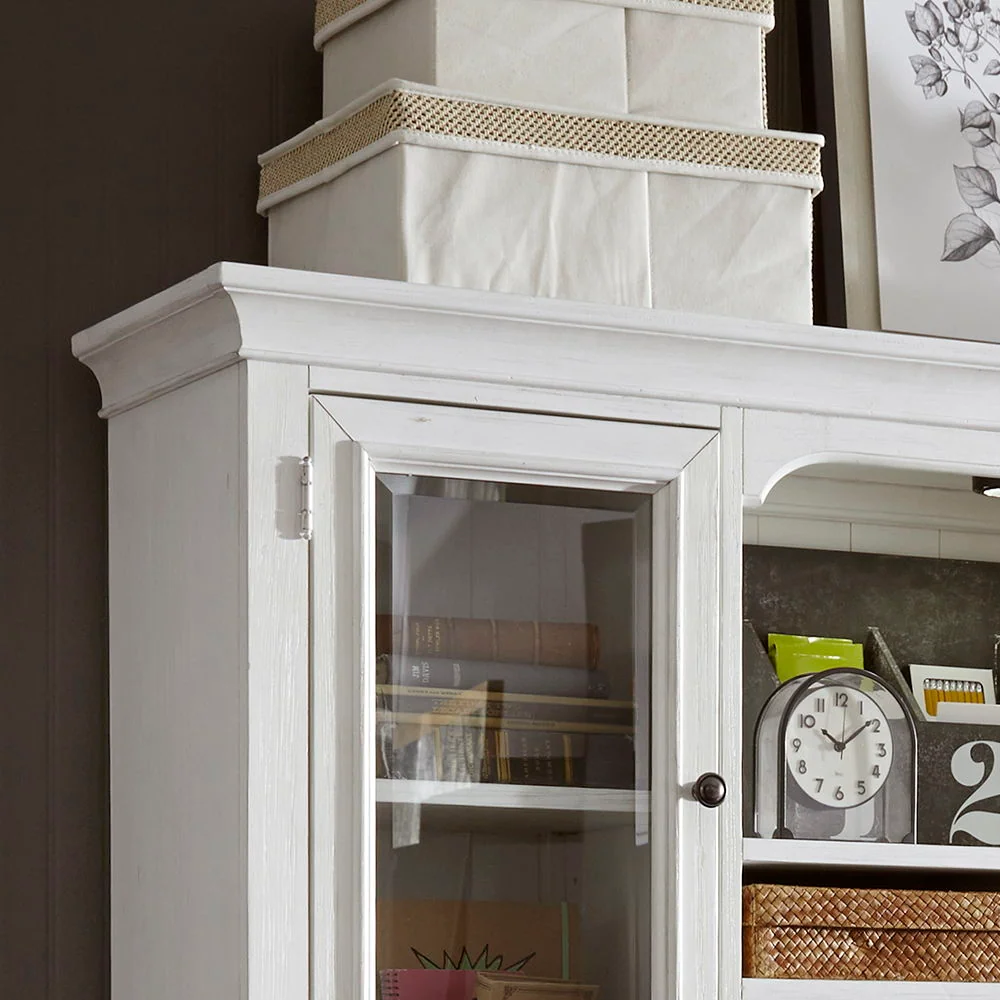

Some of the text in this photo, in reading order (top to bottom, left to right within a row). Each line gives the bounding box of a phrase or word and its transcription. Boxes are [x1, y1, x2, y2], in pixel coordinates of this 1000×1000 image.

[421, 660, 431, 683] DAVIS
[817, 698, 825, 712] 11
[833, 692, 848, 707] 12
[800, 714, 816, 728] 10
[871, 719, 881, 733] 2
[793, 738, 802, 752] 9
[877, 743, 887, 757] 3
[799, 760, 807, 774] 8
[872, 765, 880, 778] 4
[815, 778, 824, 793] 7
[857, 781, 866, 795] 5
[835, 786, 844, 800] 6
